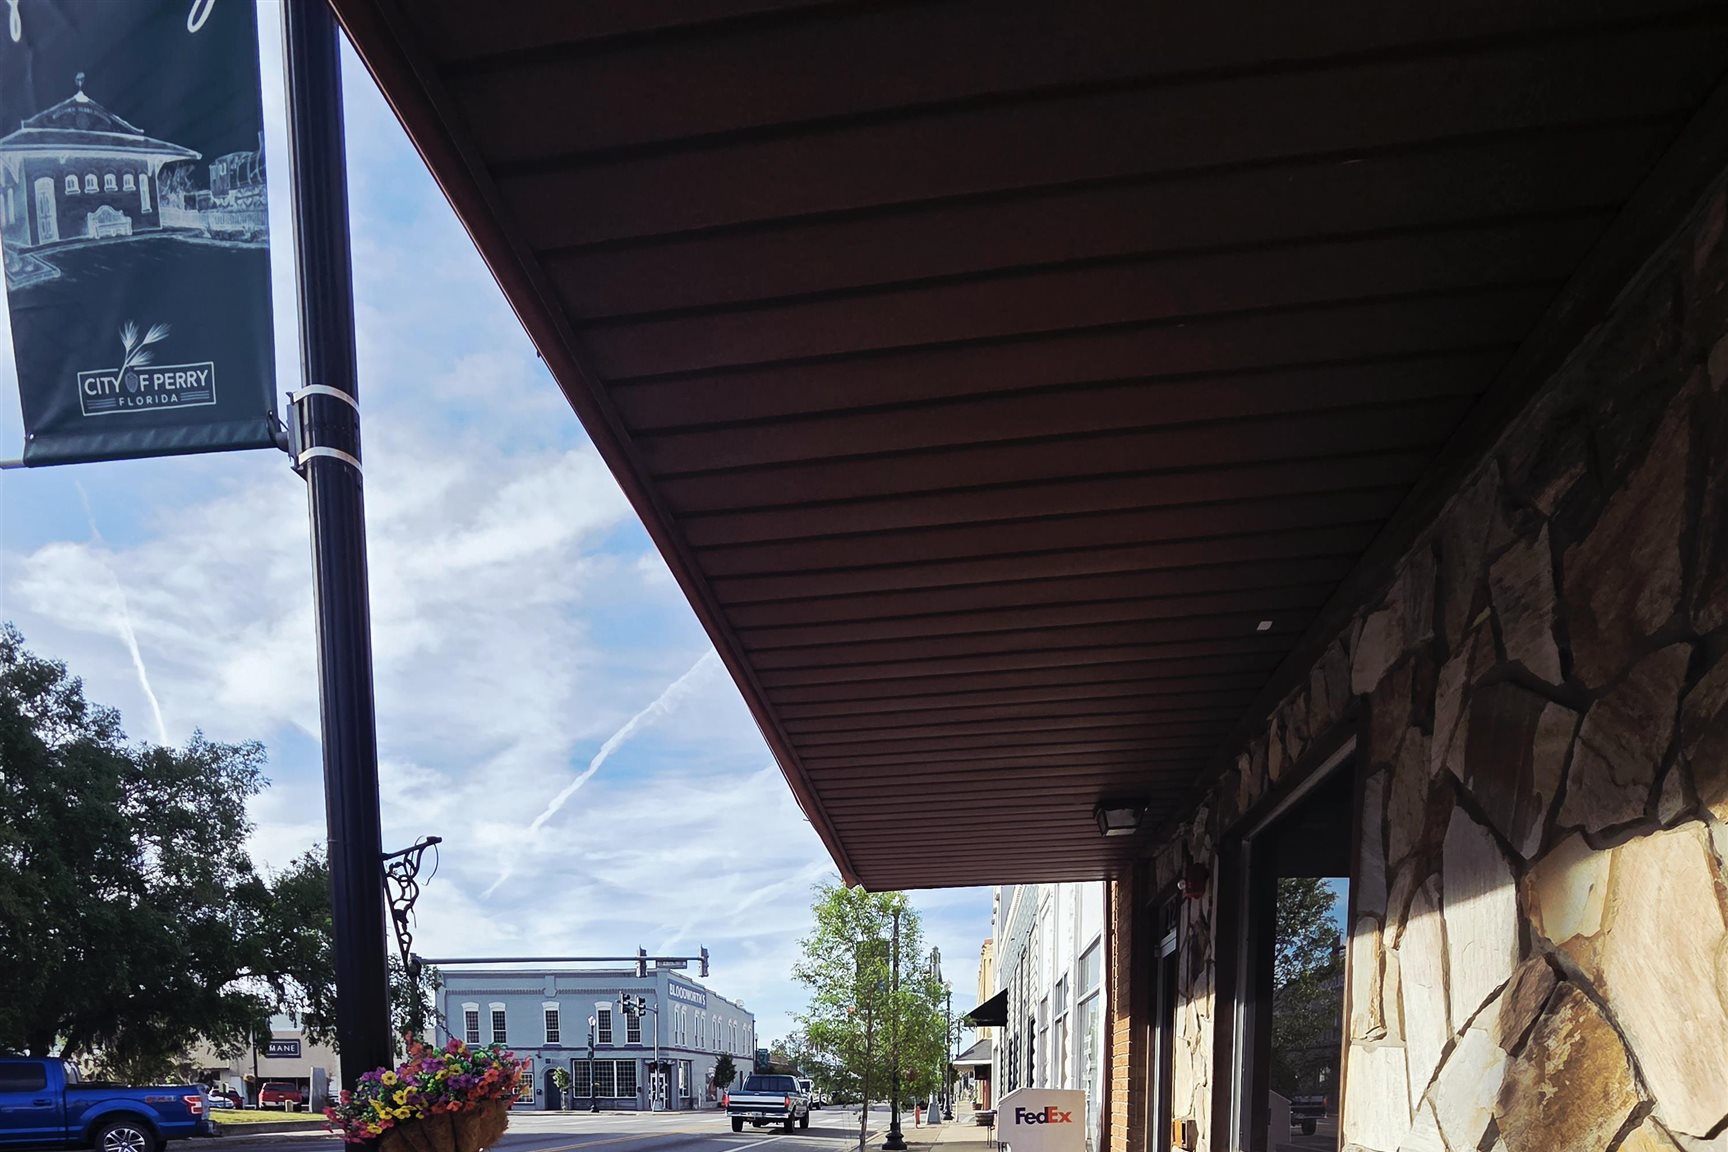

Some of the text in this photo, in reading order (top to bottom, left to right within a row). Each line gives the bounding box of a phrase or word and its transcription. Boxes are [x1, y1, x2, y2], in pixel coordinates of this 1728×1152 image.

[84, 376, 122, 396] CITY
[153, 369, 209, 391] PERRY
[118, 393, 179, 407] FLORIDA
[1015, 1106, 1073, 1125] FedEx
